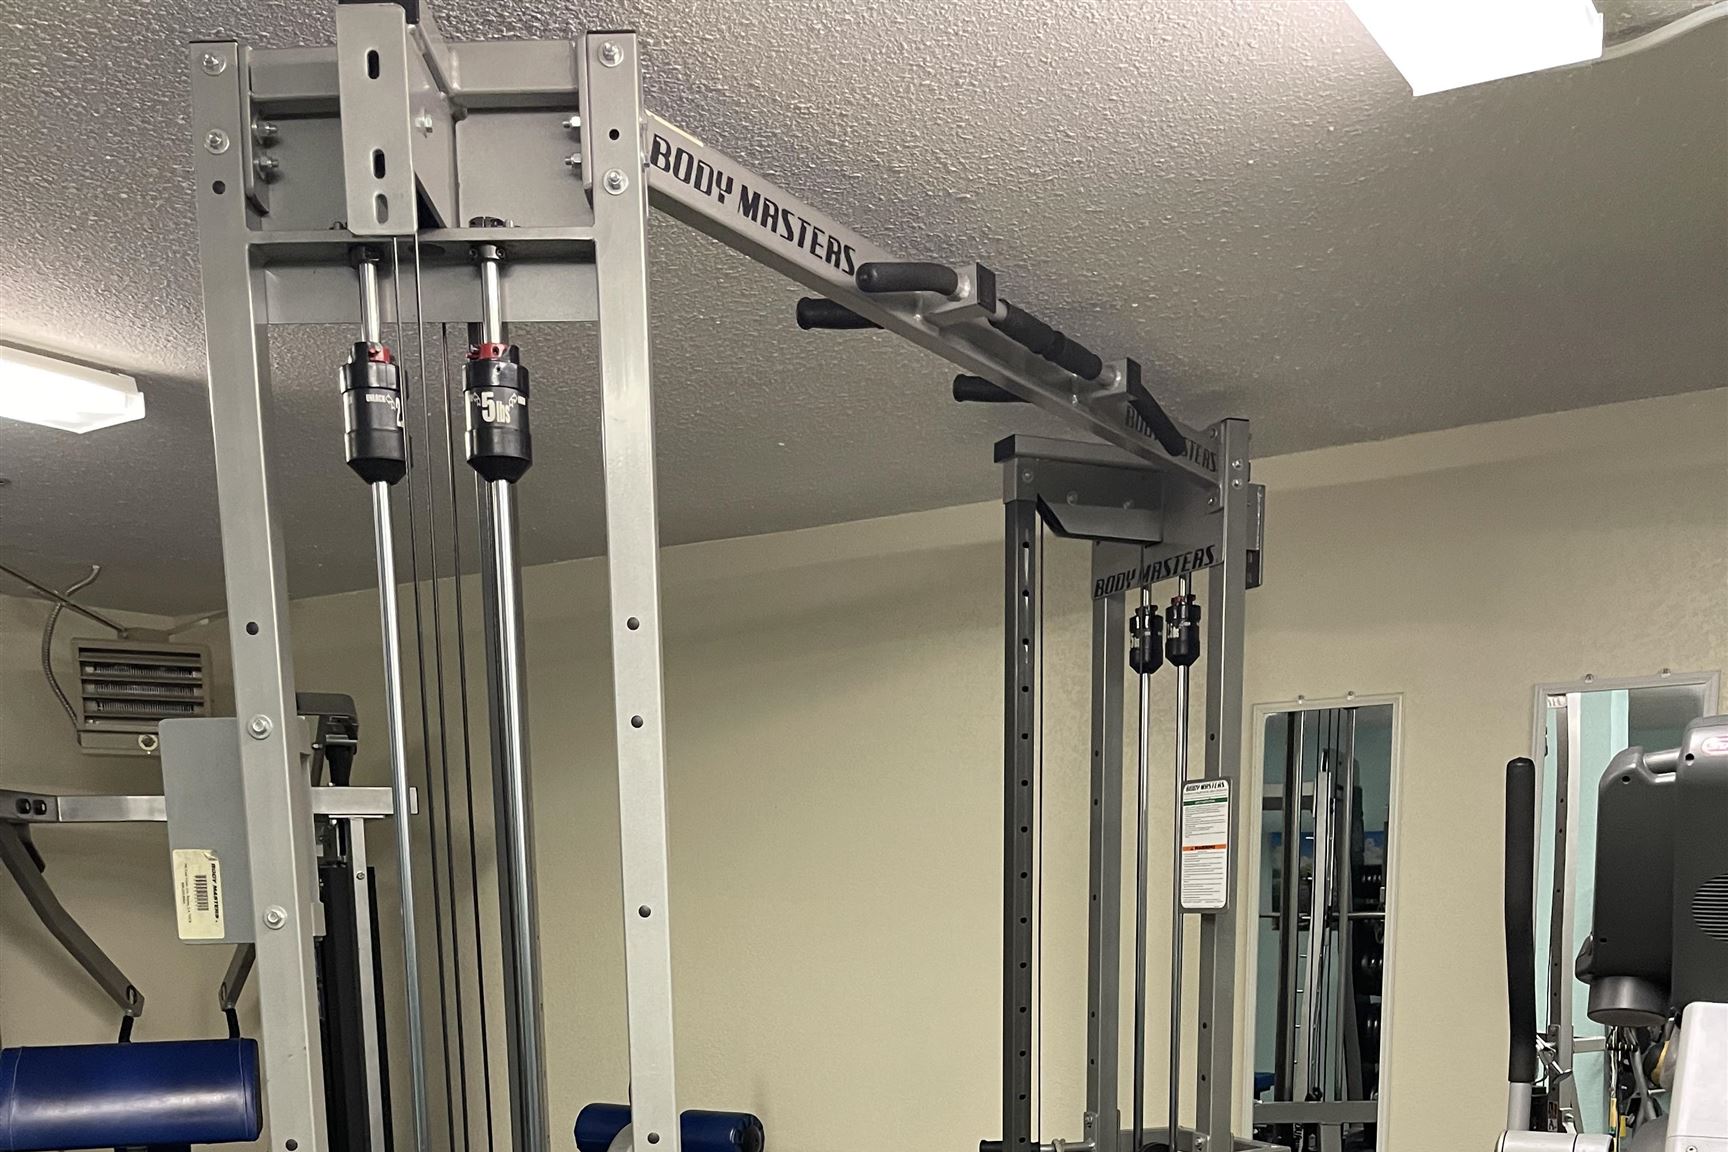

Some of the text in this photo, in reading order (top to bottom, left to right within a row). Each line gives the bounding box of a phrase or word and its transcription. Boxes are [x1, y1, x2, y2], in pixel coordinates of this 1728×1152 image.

[650, 133, 856, 276] BODY MASTERS
[1094, 544, 1216, 598] BODY MASTERS
